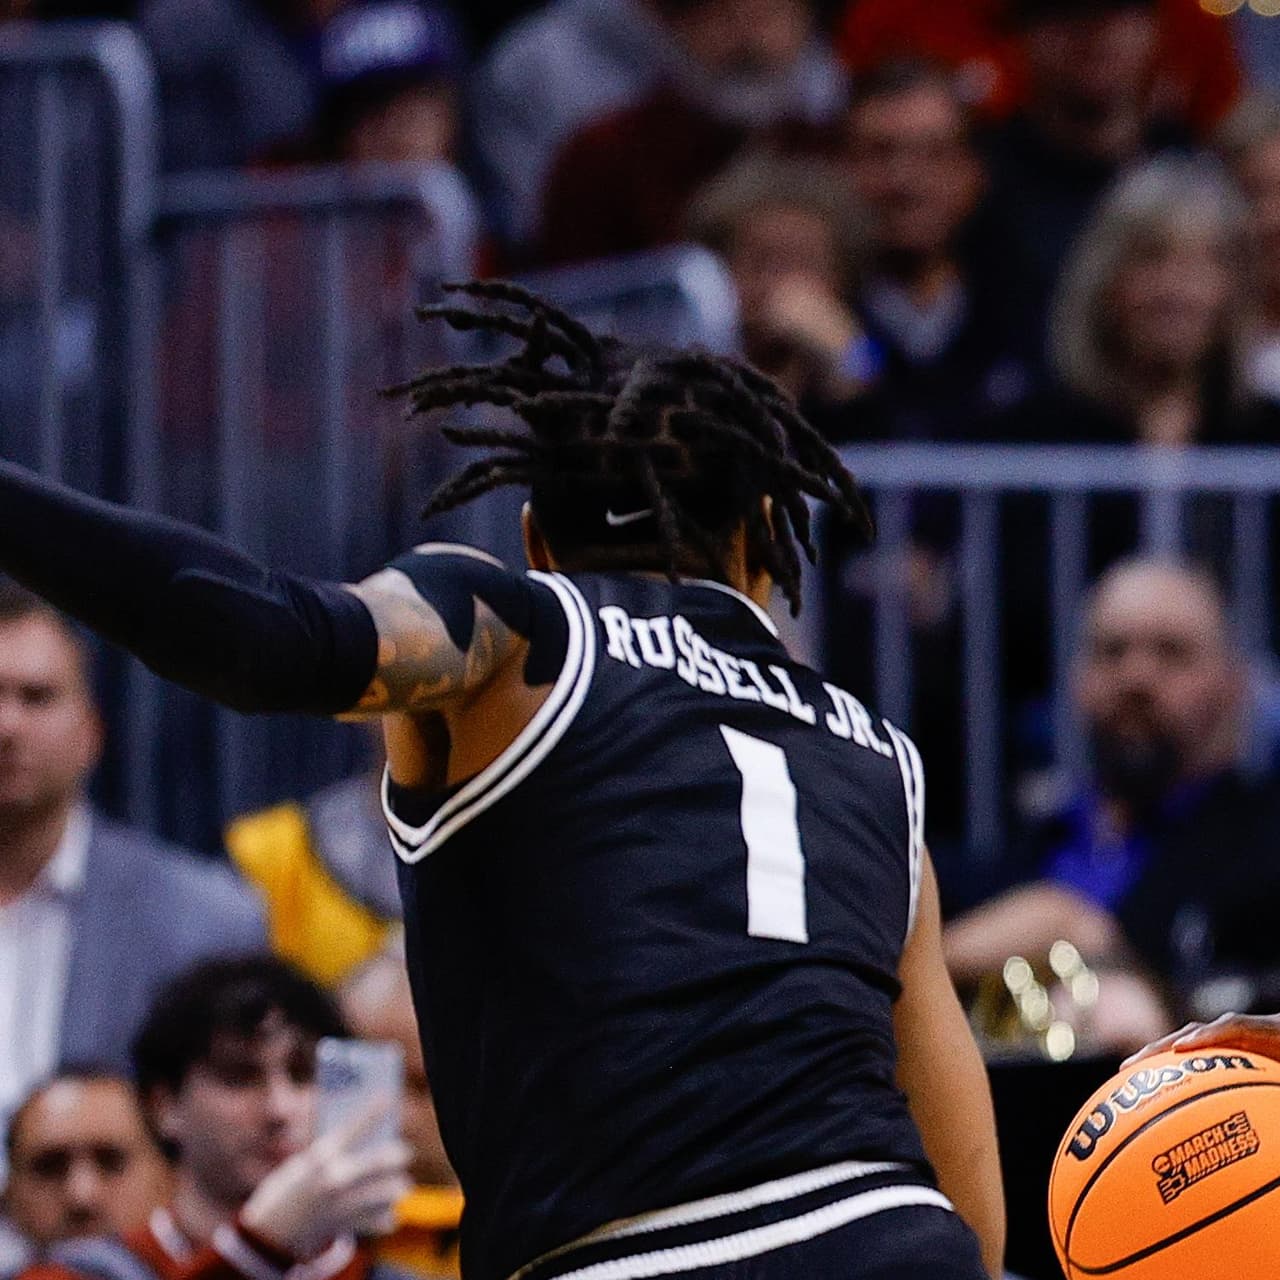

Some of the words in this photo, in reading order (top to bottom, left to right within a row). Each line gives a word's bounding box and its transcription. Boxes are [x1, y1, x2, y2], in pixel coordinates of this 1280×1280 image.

[599, 605, 816, 725] RUSSELL
[822, 682, 893, 759] JR.
[719, 724, 809, 944] 1
[1065, 1055, 1258, 1162] Wilson
[1168, 1125, 1225, 1168] MARCH
[1184, 1129, 1258, 1180] MADNESS
